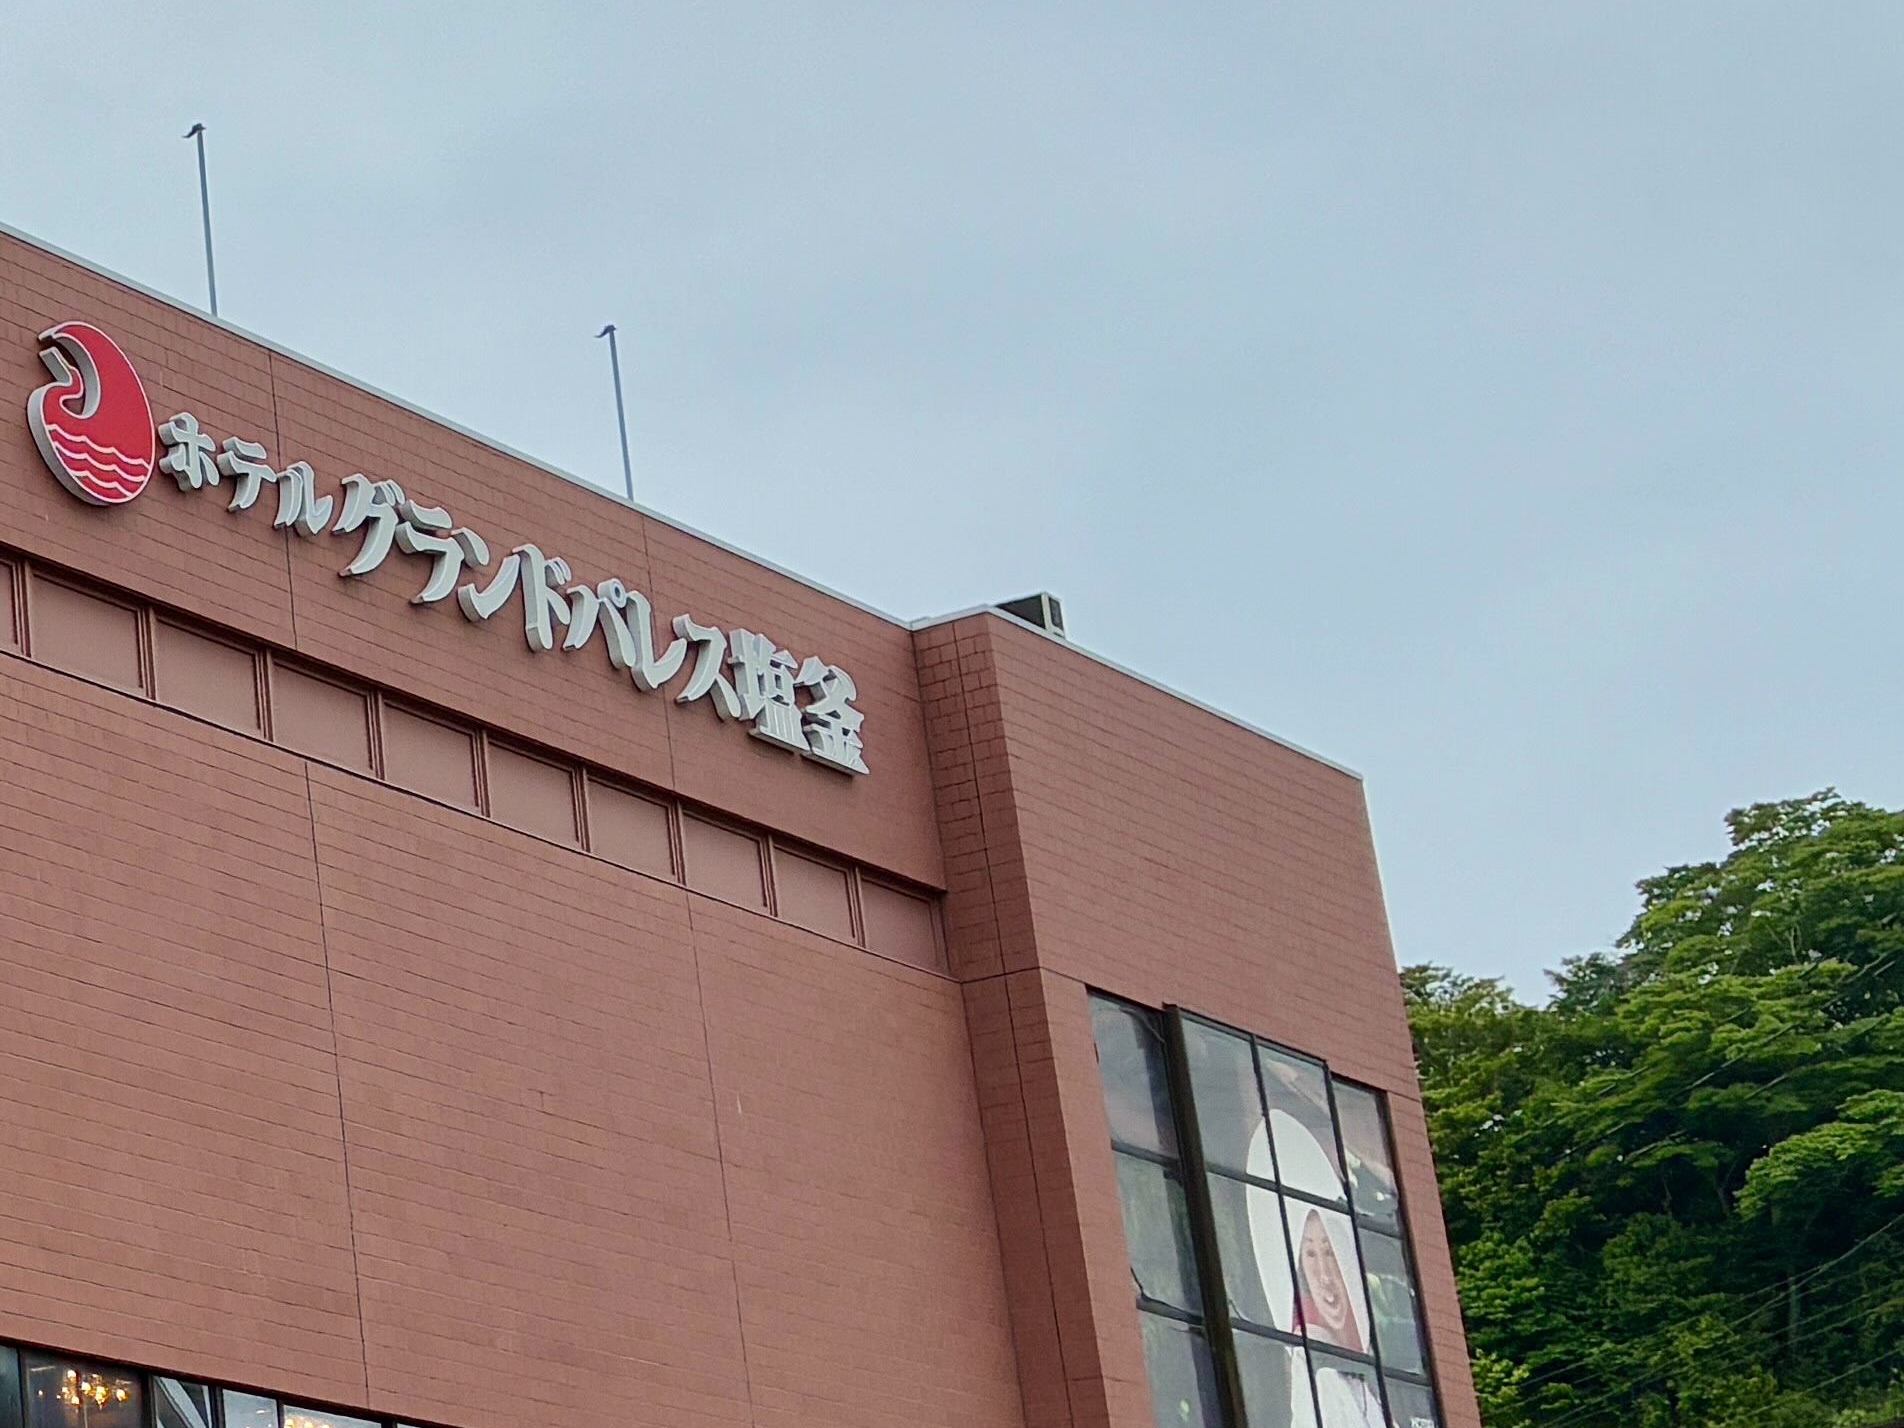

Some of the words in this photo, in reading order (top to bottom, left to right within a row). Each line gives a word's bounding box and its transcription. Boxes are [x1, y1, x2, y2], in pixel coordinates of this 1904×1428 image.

[158, 411, 871, 777] ホテルグランドパレス塩釜
